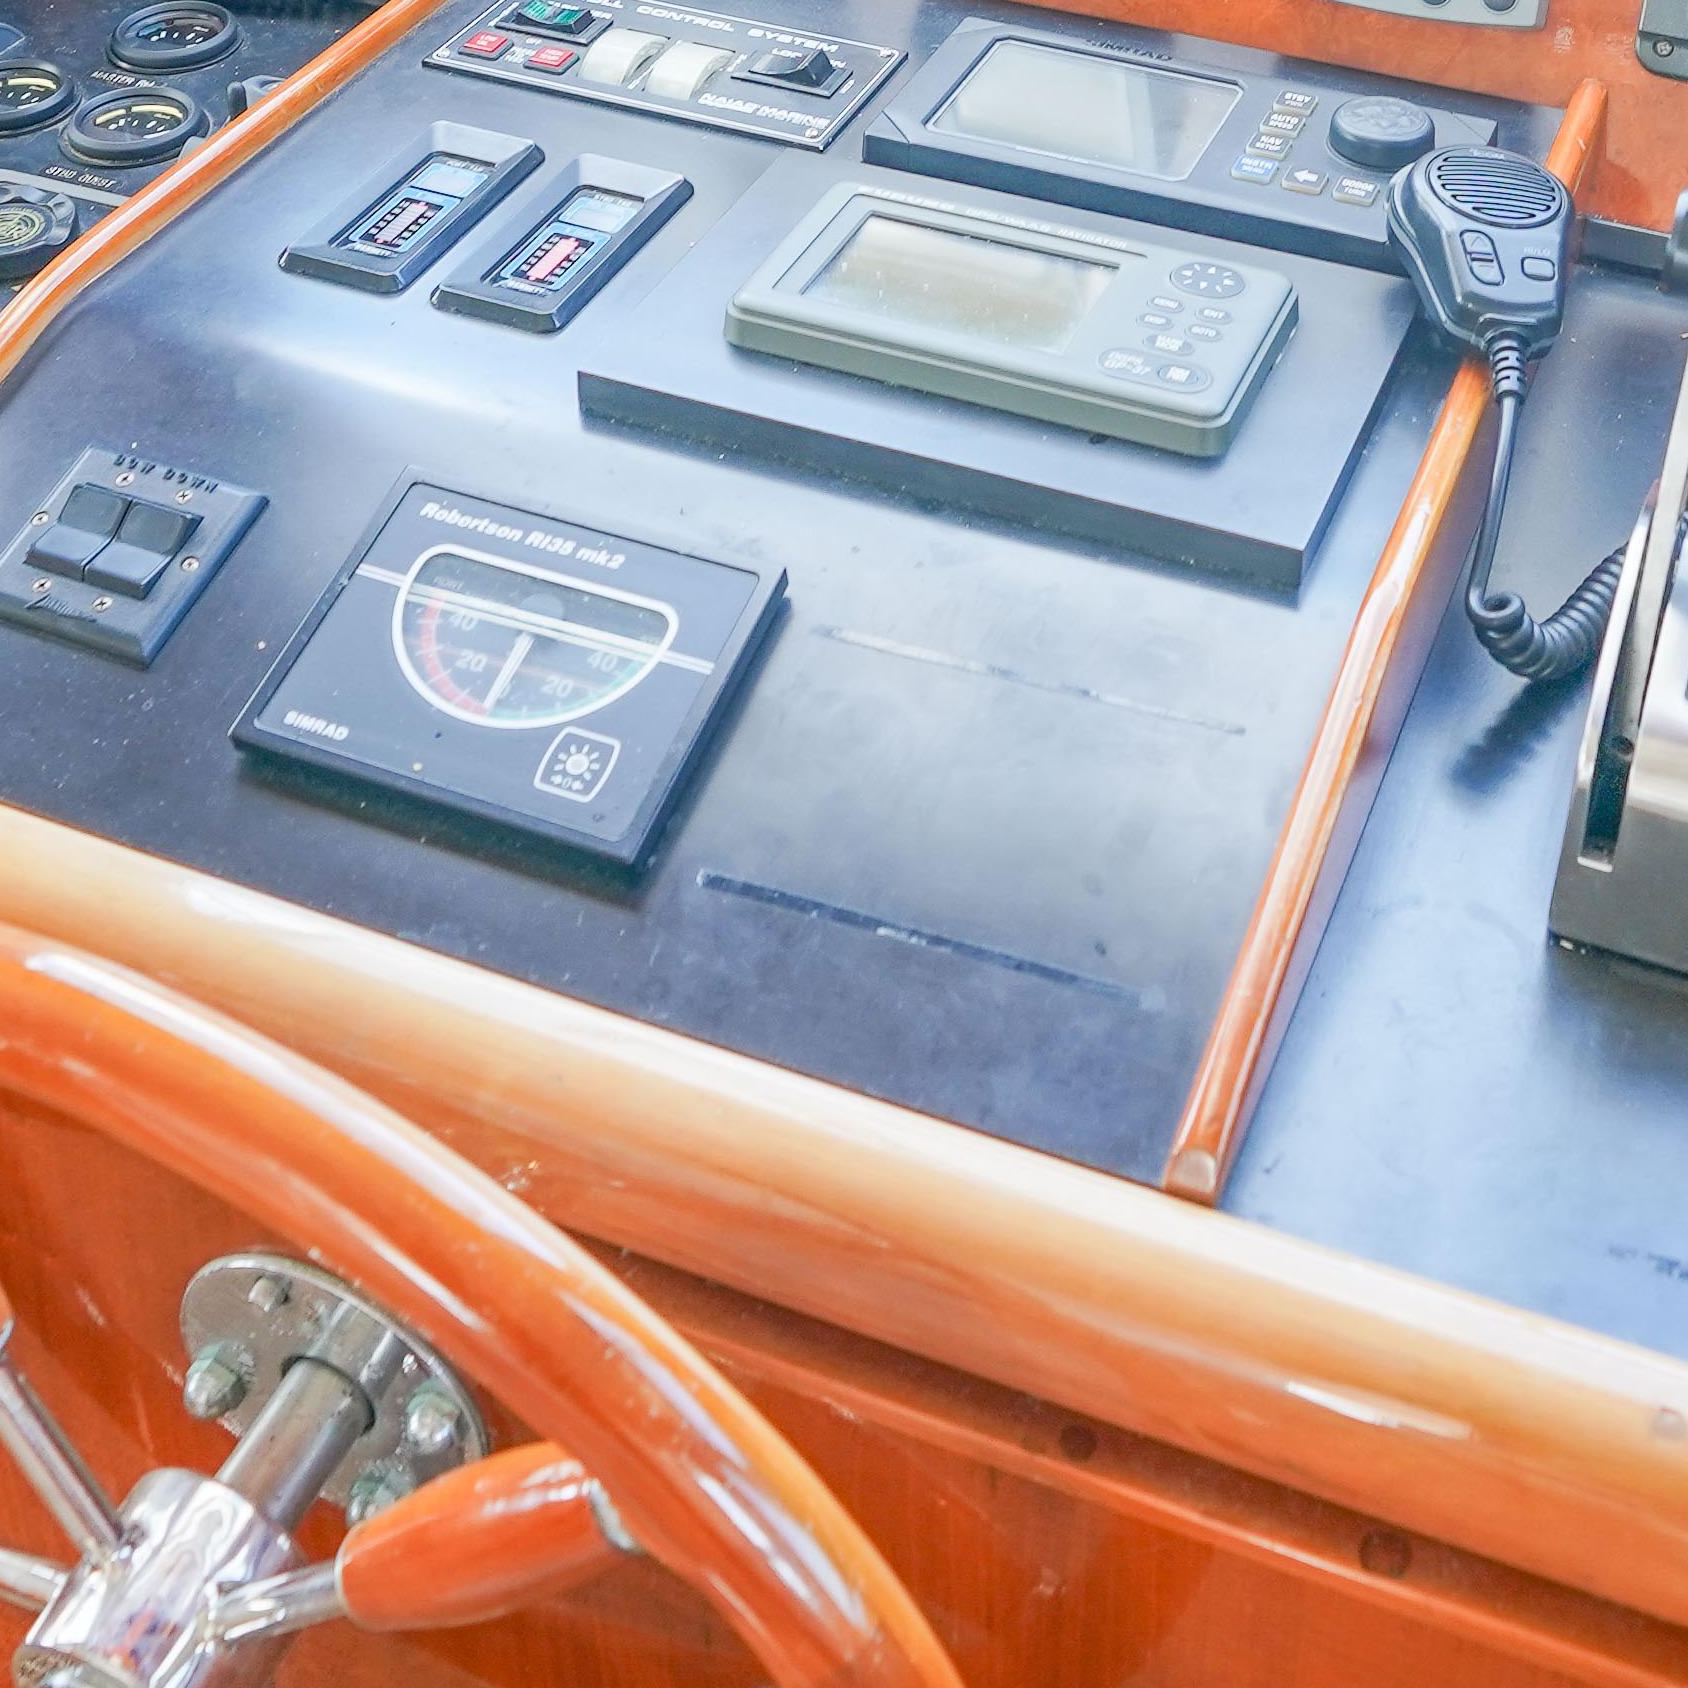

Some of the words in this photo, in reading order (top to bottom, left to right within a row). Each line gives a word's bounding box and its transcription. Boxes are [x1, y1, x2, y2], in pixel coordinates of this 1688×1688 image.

[635, 4, 736, 33] CONTROL
[747, 27, 840, 54] SYSTEM
[91, 69, 135, 87] MASTER
[1270, 113, 1299, 124] AUTO
[1260, 134, 1284, 146] NAV
[1057, 227, 1128, 250] NAVIGATOR
[1190, 325, 1217, 337] GOTO
[419, 501, 524, 544] Robertson
[574, 546, 627, 571] mk2
[448, 612, 481, 632] 40
[456, 650, 488, 673] 20
[586, 650, 622, 673] 40
[540, 674, 574, 698] 20
[283, 710, 350, 741] SIMRAD
